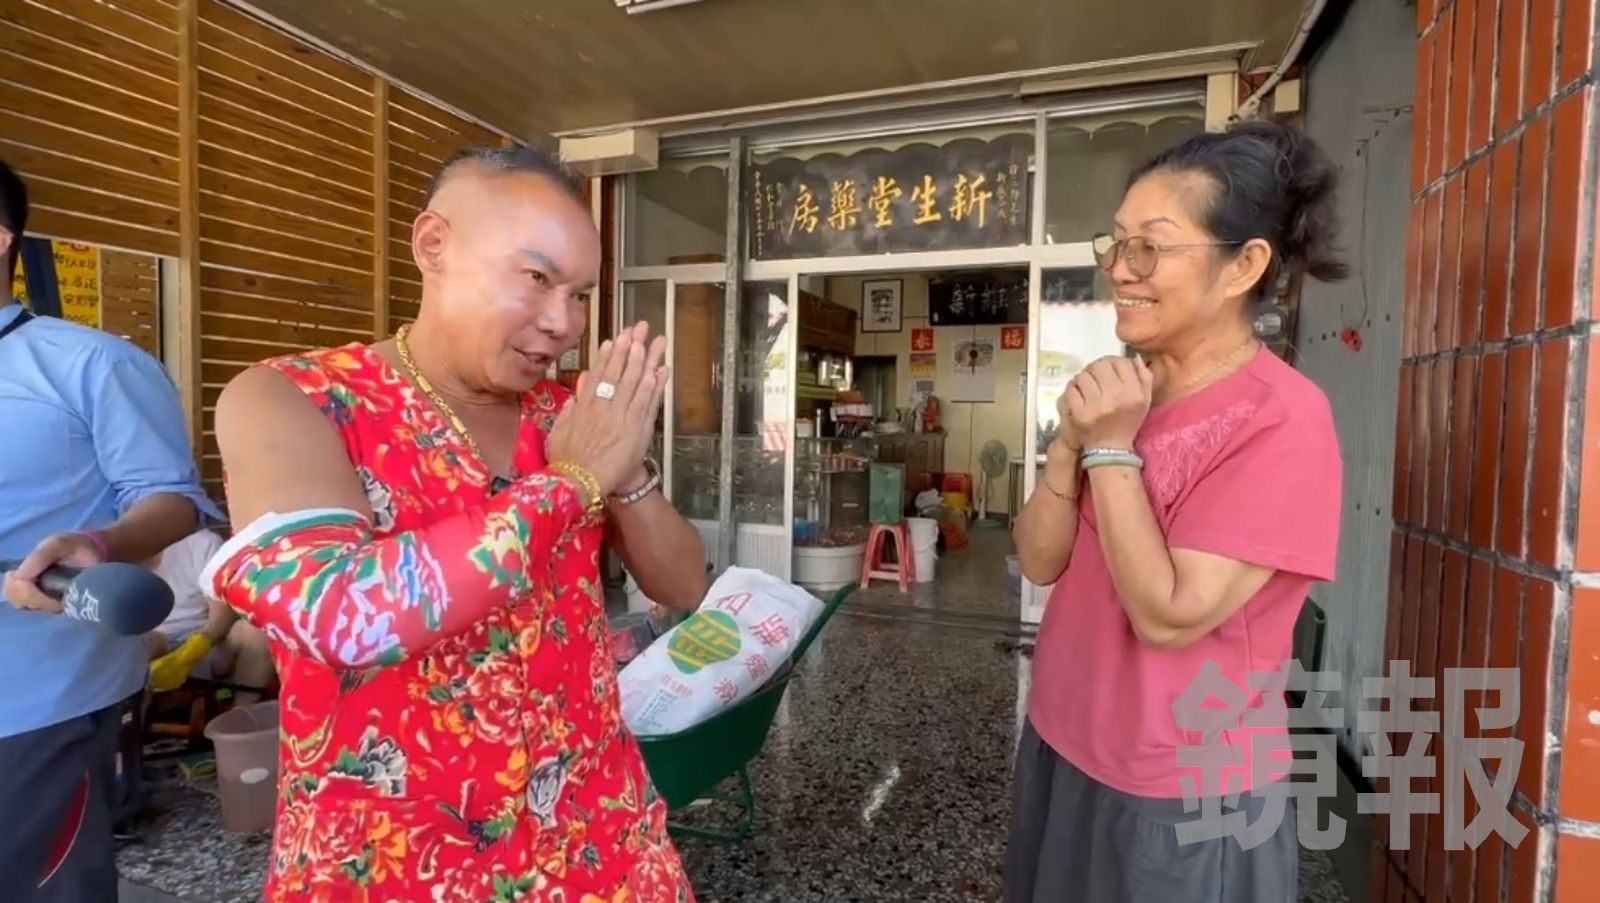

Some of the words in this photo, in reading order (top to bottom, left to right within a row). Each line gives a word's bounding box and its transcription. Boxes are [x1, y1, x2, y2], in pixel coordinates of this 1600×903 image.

[788, 173, 993, 236] 新生堂藥房
